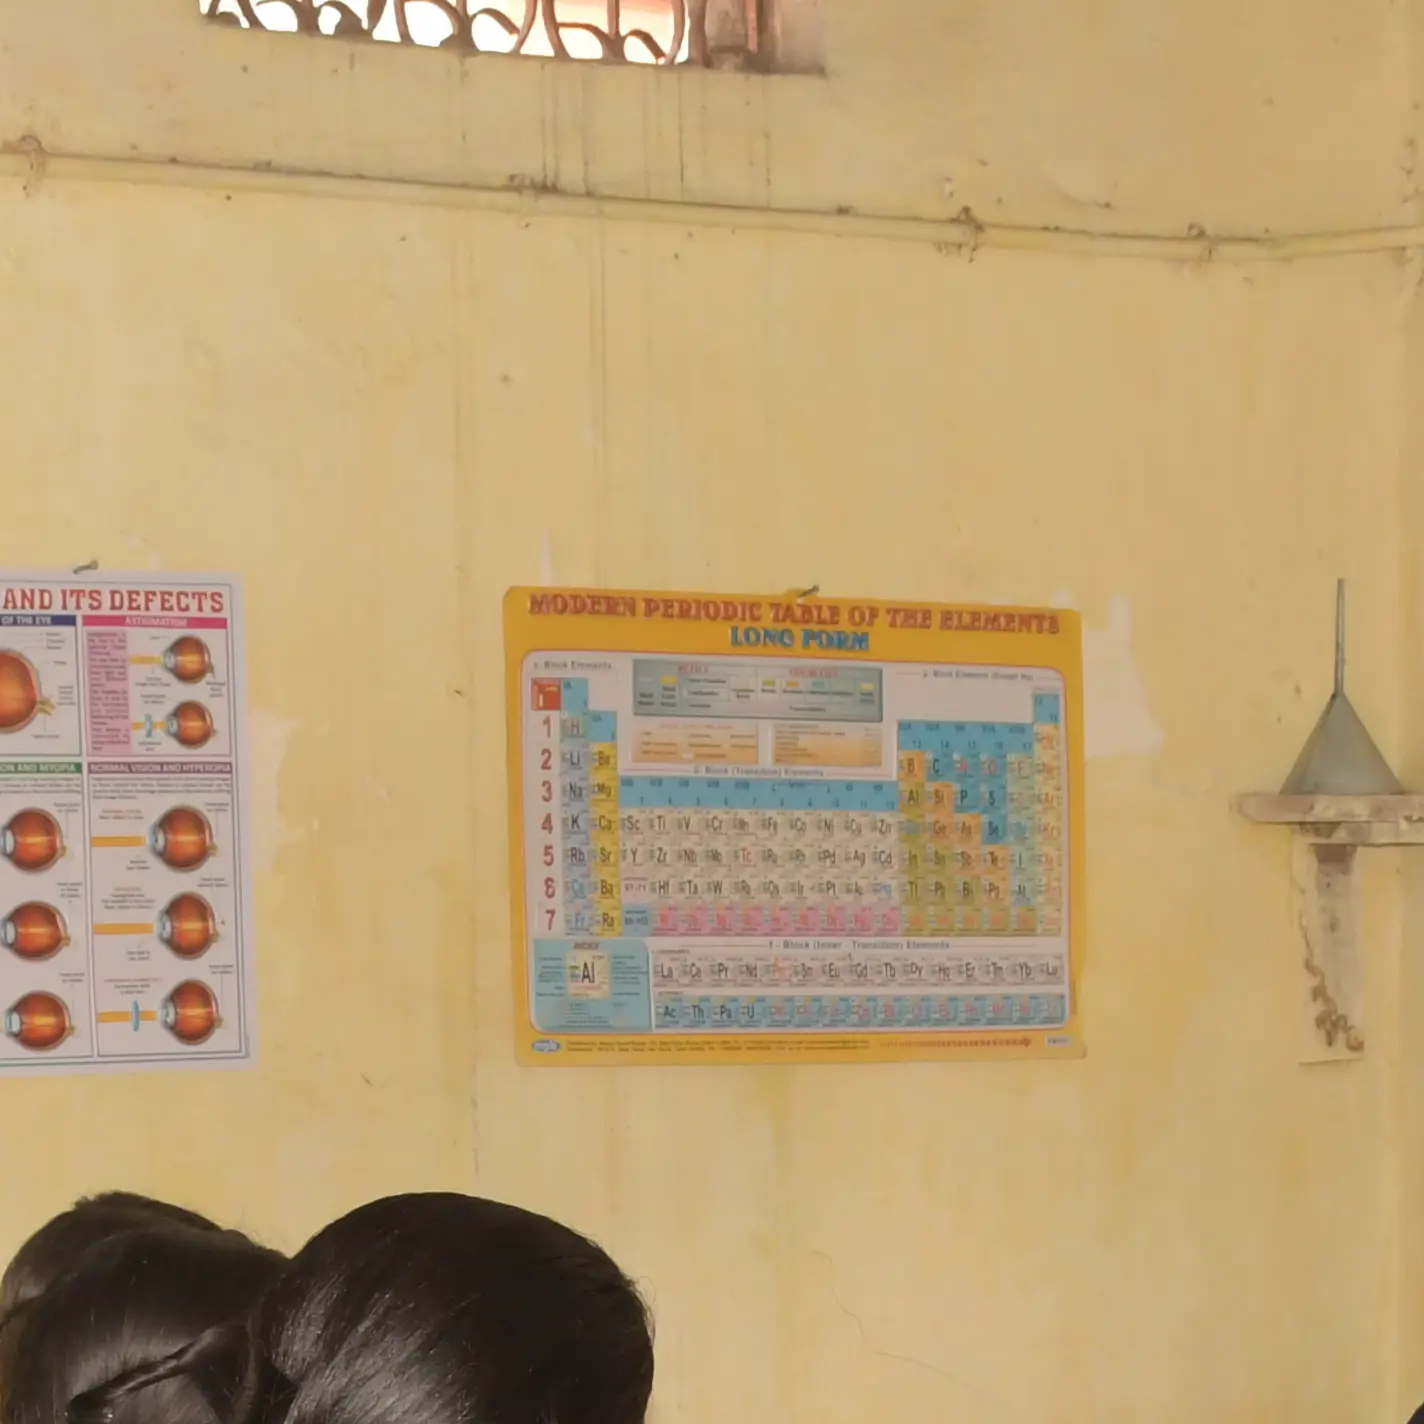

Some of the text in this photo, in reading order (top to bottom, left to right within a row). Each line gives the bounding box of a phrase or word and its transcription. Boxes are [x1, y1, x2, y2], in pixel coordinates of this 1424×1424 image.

[3, 588, 53, 610] AND
[61, 589, 102, 611] ITS
[109, 590, 224, 613] DEFECTS
[528, 593, 1059, 635] MODERN PERIODIC TABLE OF THE ELEMENTS
[730, 626, 869, 651] LONG FORM
[542, 715, 551, 738] 1
[541, 748, 552, 770] 2
[542, 781, 552, 802] 3
[960, 789, 968, 804] P
[989, 790, 996, 806] S
[542, 813, 553, 835] 4
[571, 815, 581, 830] K
[627, 816, 640, 831] Sc
[683, 815, 691, 830] V
[711, 816, 723, 831] Cr
[879, 818, 891, 834] Zn
[544, 845, 554, 866] 5
[570, 848, 585, 862] Rb
[631, 848, 638, 863] Y
[657, 848, 667, 863] Zr
[741, 848, 752, 863] Tc
[853, 849, 866, 866] Ag
[879, 850, 892, 865] Cd
[544, 877, 555, 899] 6
[601, 879, 614, 895] Ba
[659, 880, 670, 894] Hf
[687, 880, 698, 894] Ta
[545, 909, 556, 931] 7
[602, 913, 615, 928] Ra
[661, 963, 673, 978] La
[718, 962, 729, 978] Pr
[746, 963, 757, 978] Nd
[829, 963, 840, 978] Eu
[855, 963, 868, 978] Gd
[884, 963, 896, 978] Tb
[911, 962, 923, 977] Dy
[1018, 962, 1031, 978] Yb
[663, 1004, 676, 1019] Ac
[692, 1004, 704, 1019] Th
[747, 1005, 755, 1019] U
